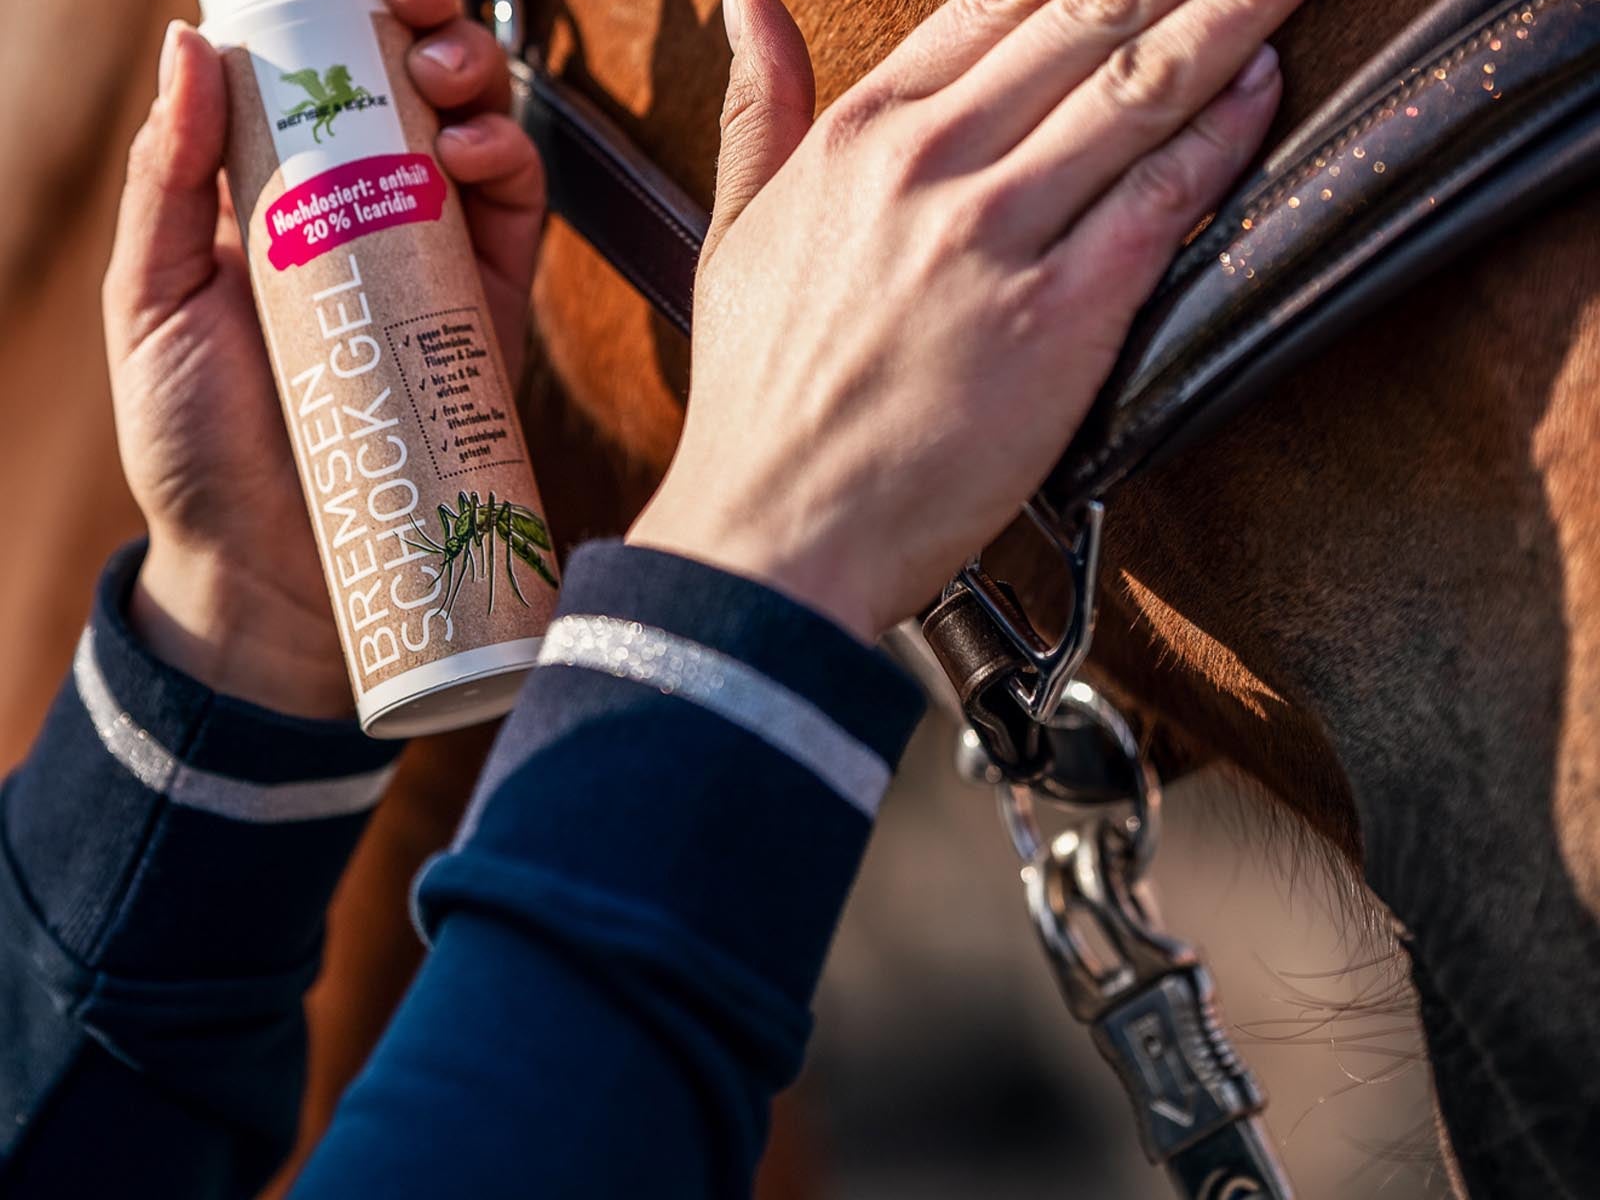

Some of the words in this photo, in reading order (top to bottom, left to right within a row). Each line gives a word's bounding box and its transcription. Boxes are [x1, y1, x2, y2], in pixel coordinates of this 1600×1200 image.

[272, 178, 375, 236] Hochdosiert:
[303, 218, 329, 245] 20
[329, 209, 351, 233] %
[353, 192, 417, 224] Icaridin
[312, 253, 382, 379] GEL
[292, 363, 400, 677] BREMSEN
[342, 386, 453, 653] SCHOCK
